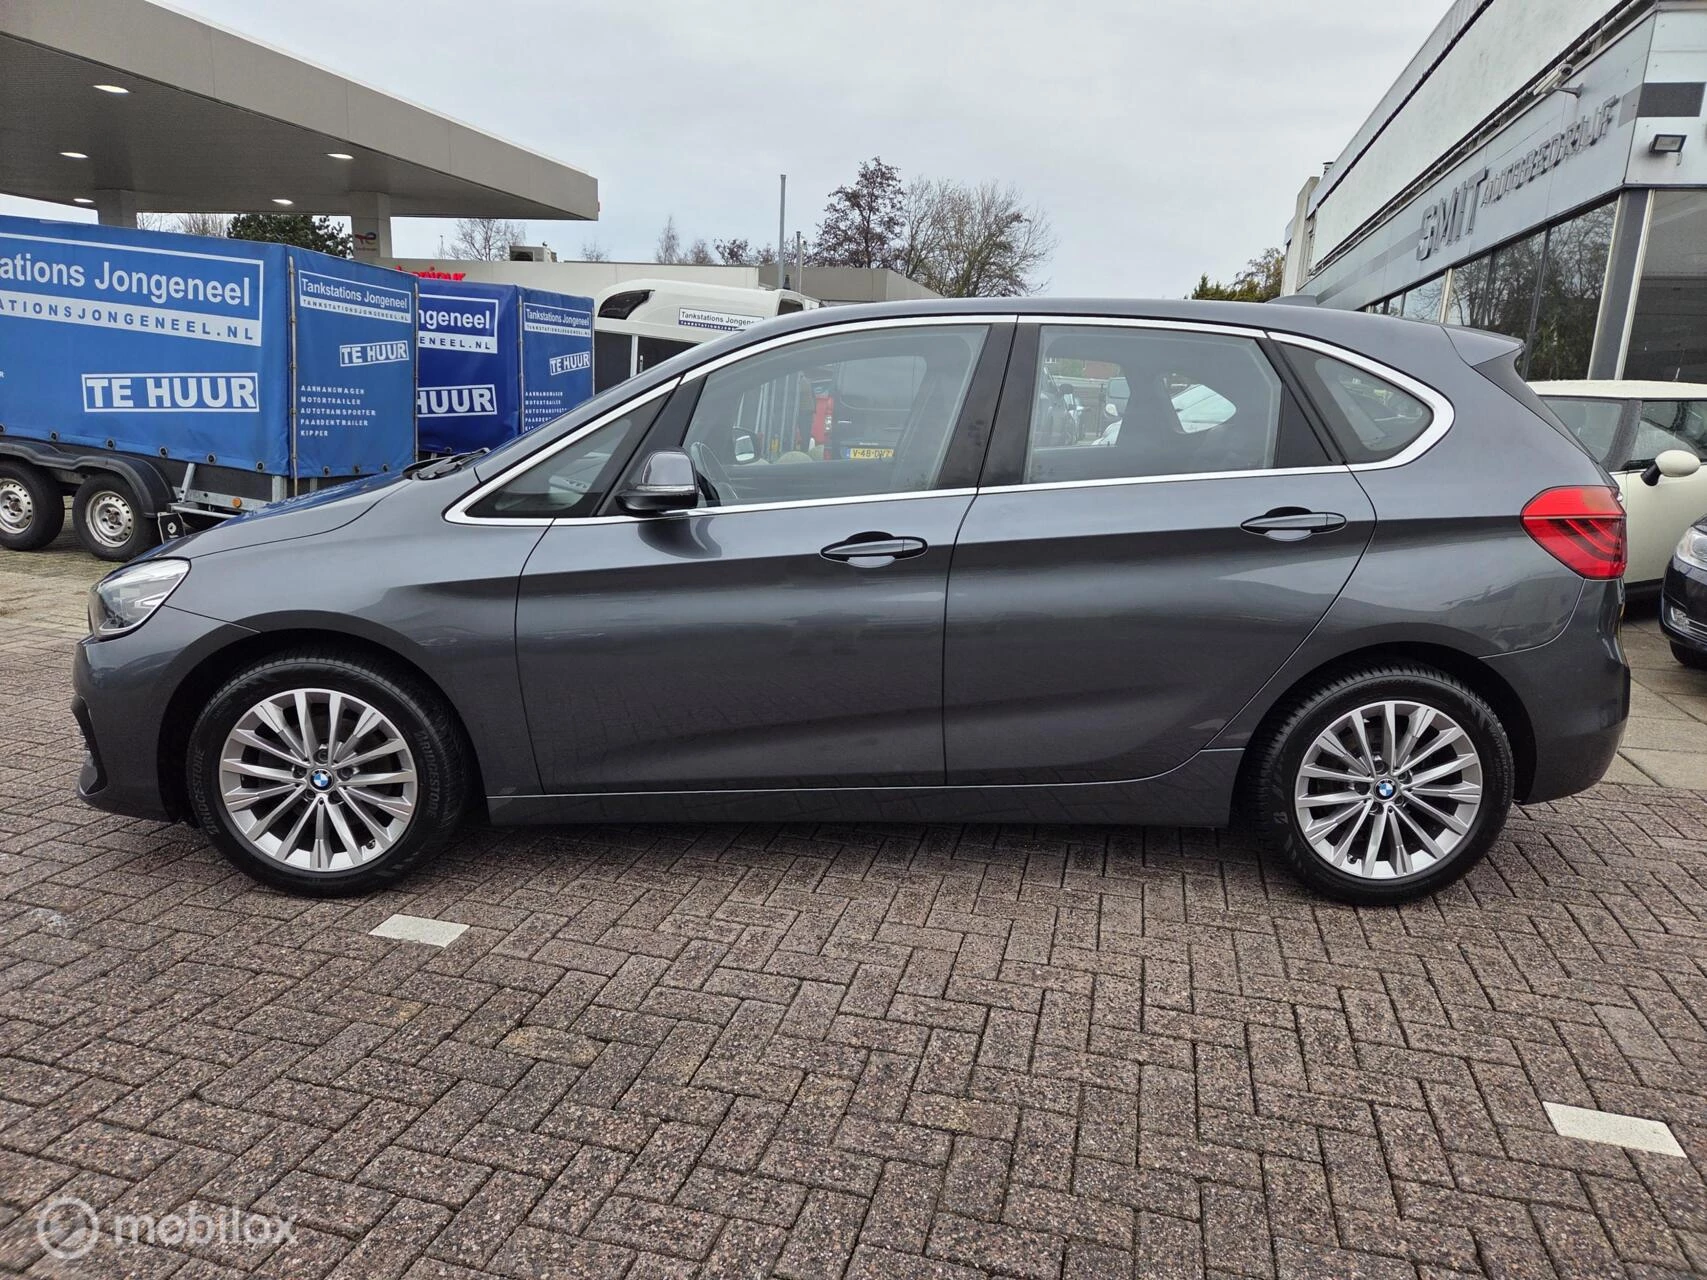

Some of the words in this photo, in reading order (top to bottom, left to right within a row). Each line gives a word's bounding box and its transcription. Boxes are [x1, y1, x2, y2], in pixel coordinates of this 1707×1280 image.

[1416, 166, 1489, 261] SMIT
[1481, 95, 1620, 207] AUTOBEDRIJF
[0, 253, 85, 287] ations
[95, 261, 249, 307] Jongeneel
[302, 278, 362, 301] Tankstations
[364, 291, 408, 309] Jongeneel
[526, 308, 562, 323] Tankstations
[562, 314, 590, 327] Jongeneel
[681, 311, 724, 323] Tankstations
[341, 347, 363, 364] TE
[366, 343, 407, 362] HUUR
[550, 358, 562, 373] TE
[563, 353, 590, 370] HUUR
[86, 378, 133, 408] TE
[146, 378, 256, 408] HUUR
[417, 388, 495, 414] HUUR
